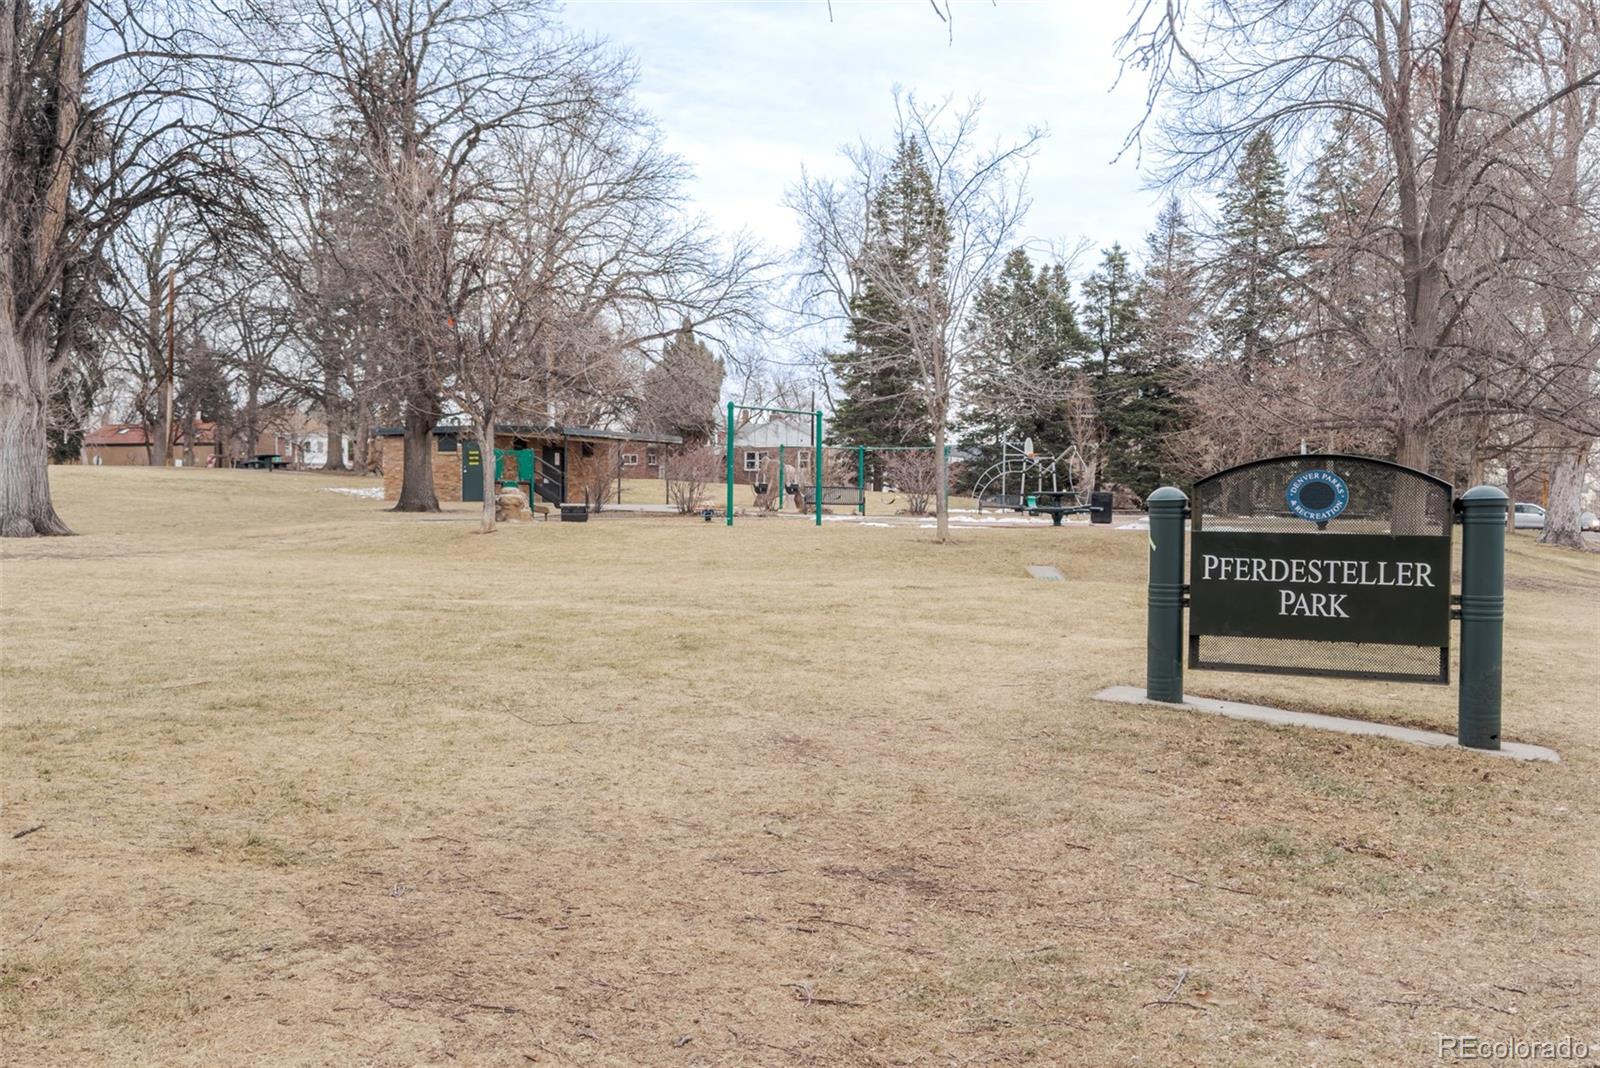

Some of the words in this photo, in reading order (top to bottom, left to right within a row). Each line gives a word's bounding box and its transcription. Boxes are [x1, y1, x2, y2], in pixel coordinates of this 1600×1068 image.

[1290, 473, 1320, 494] DENVER
[1321, 473, 1344, 494] PARKS
[1295, 500, 1343, 519] RECREATION
[1202, 554, 1435, 587] PFERDESTELLER
[1278, 589, 1349, 618] PARK
